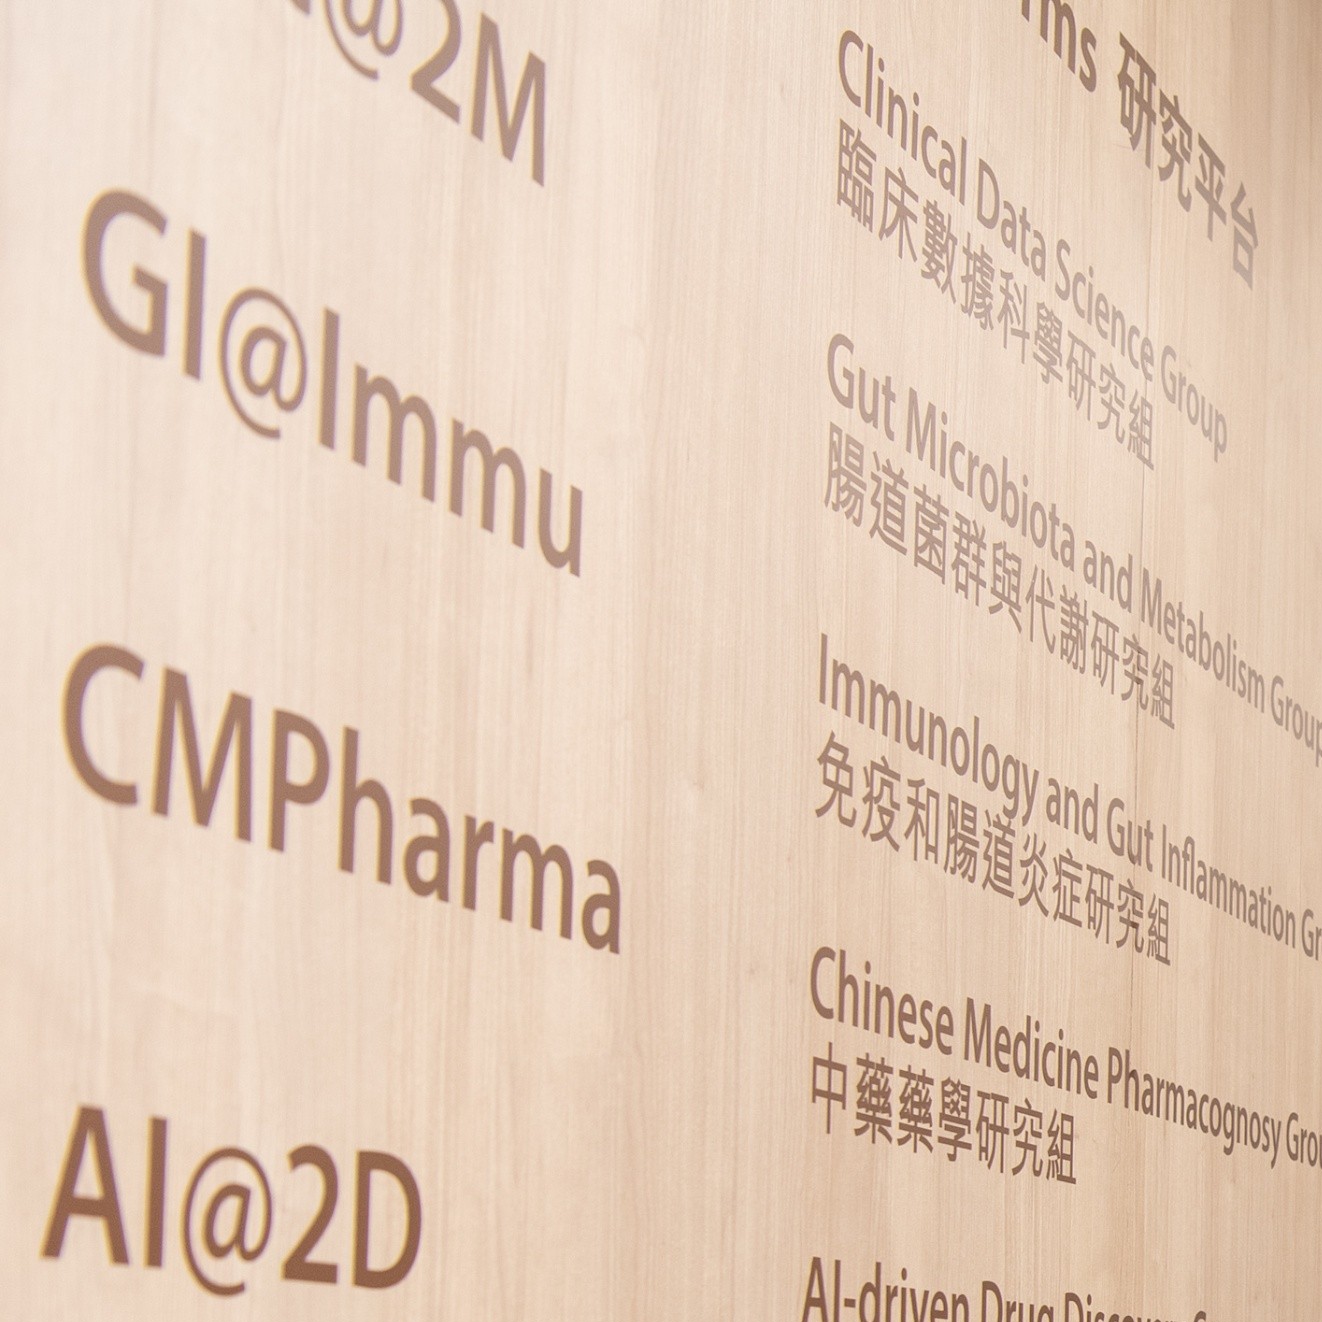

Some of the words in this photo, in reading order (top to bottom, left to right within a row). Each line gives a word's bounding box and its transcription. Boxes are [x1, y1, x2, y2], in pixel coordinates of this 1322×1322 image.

[837, 118, 1155, 471] 臨床數據科學研究組
[838, 29, 967, 206] Clinical
[976, 157, 1047, 282] Data
[1055, 239, 1155, 382] Science
[1160, 345, 1228, 464] Group
[1117, 31, 1259, 291] 研究平台
[81, 187, 584, 578] GI@Immu
[827, 333, 896, 441] Gut
[906, 387, 1075, 571] Microbiota
[1082, 539, 1133, 613] and
[1141, 567, 1265, 714] Metabolism
[823, 420, 1176, 731] 腸道菌群與代謝研究組
[61, 642, 622, 956] CMPharma
[815, 731, 1171, 967] 免疫和腸道炎症研究組
[818, 633, 1039, 827] Immunology
[1045, 777, 1099, 844] and
[1105, 797, 1153, 872] Gut
[1160, 823, 1296, 950] Inflammation
[38, 1103, 423, 1298] AI@2D
[810, 945, 954, 1056] Chinese
[963, 996, 1099, 1100] Medicine
[1107, 1046, 1282, 1170] Pharmacognosy
[810, 1041, 1077, 1185] 中藥藥學研究組
